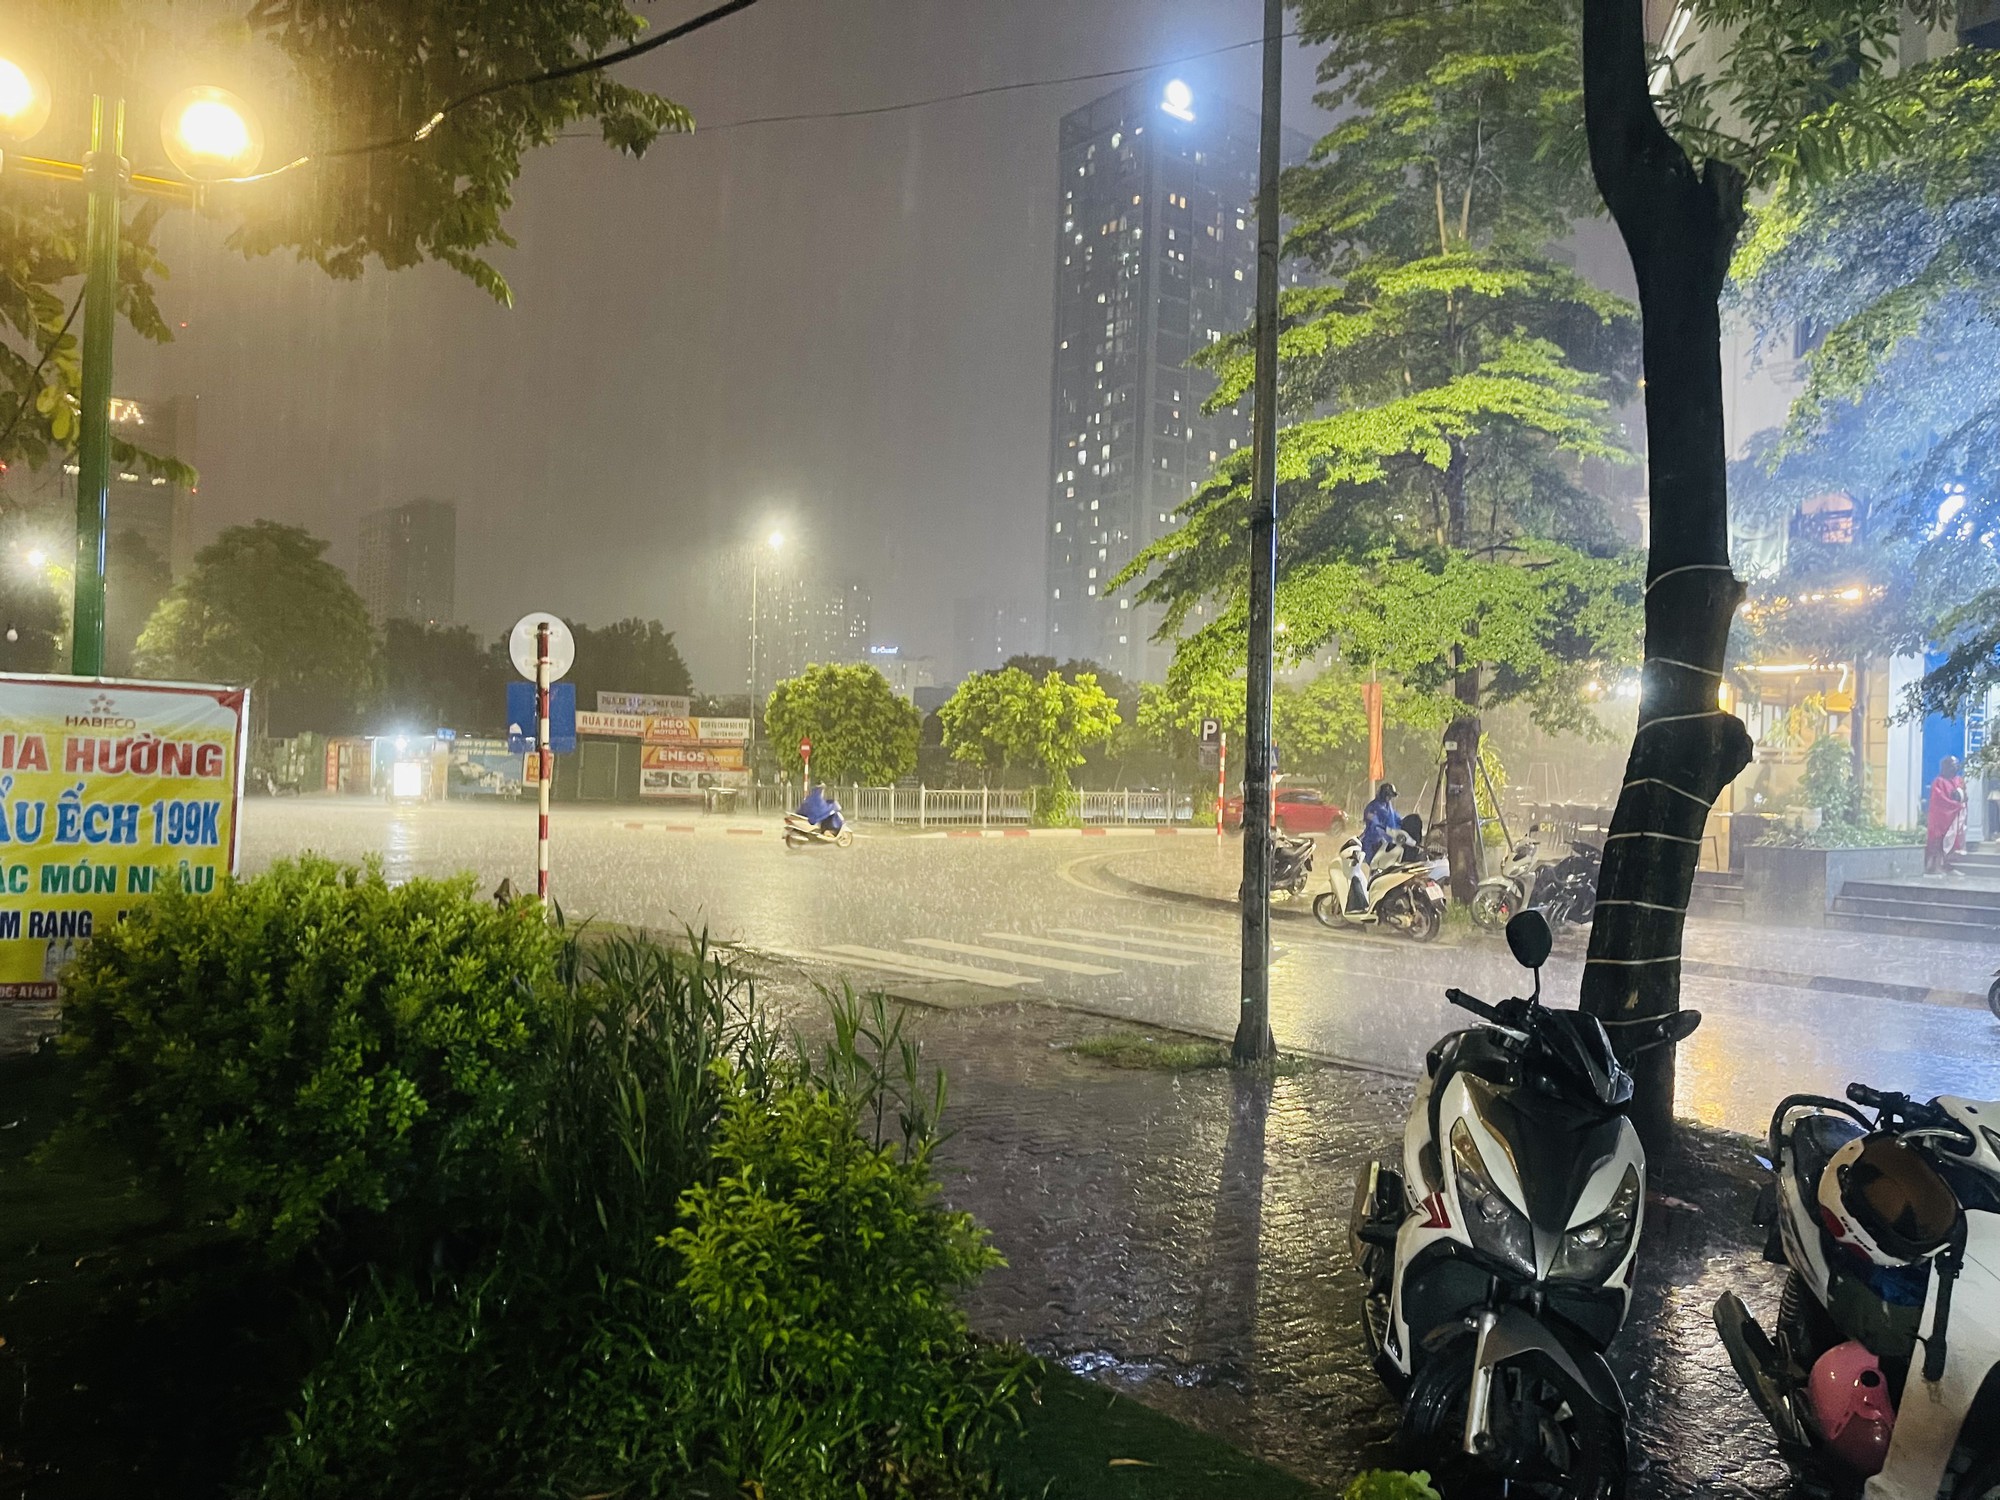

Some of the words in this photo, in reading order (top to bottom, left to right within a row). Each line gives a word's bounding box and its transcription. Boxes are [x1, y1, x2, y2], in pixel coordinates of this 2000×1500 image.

[65, 715, 137, 730] HABECO
[1203, 720, 1218, 741] P
[65, 732, 223, 777] HƯỜNG
[659, 750, 704, 762] ENEOS
[54, 782, 139, 844] ẾCH
[152, 801, 219, 845] 199K
[128, 860, 214, 894] NU
[29, 910, 92, 939] RANG
